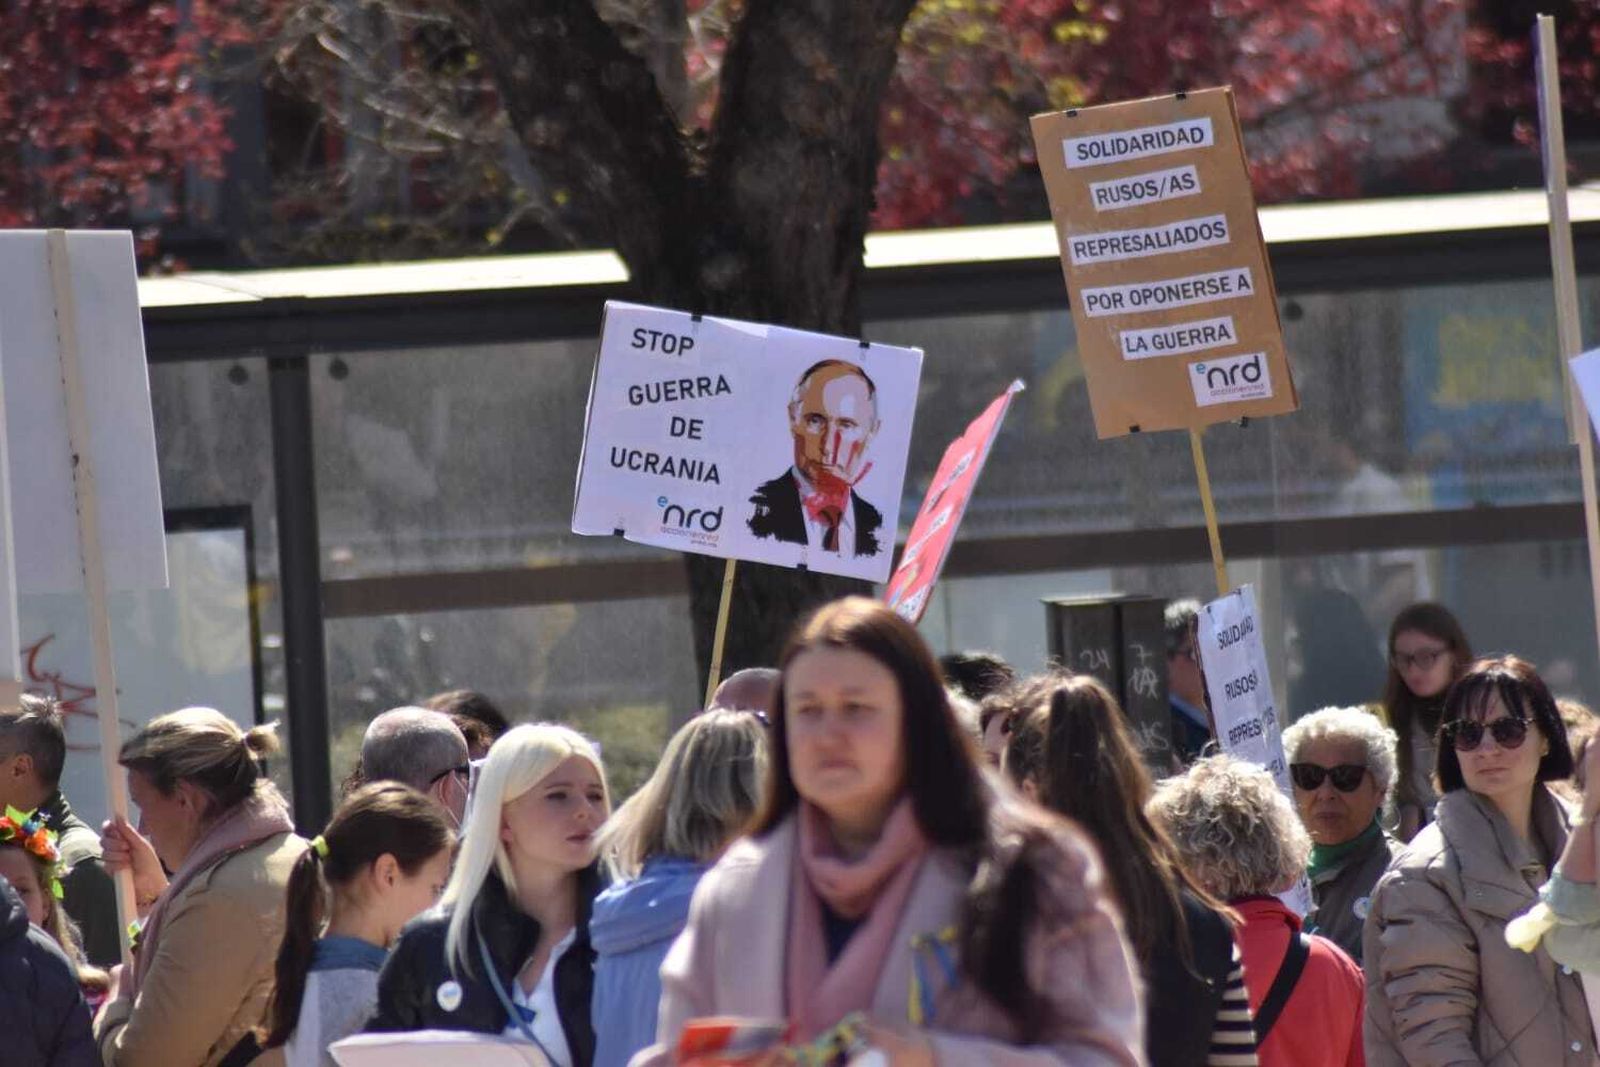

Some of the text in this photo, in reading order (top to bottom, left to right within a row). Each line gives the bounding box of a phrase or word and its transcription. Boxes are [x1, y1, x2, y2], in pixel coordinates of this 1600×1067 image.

[1076, 126, 1205, 161] SOLIDARIDAD
[1095, 172, 1196, 206] RUSOS/AS
[1073, 221, 1227, 258] REPRESALIADOS
[1086, 273, 1251, 312] POR OPONERSE A
[631, 327, 695, 357] STOP
[1125, 322, 1231, 354] LA GUERRA
[628, 373, 732, 406] GUERRA
[670, 416, 704, 440] DE
[610, 446, 721, 485] UCRANIA
